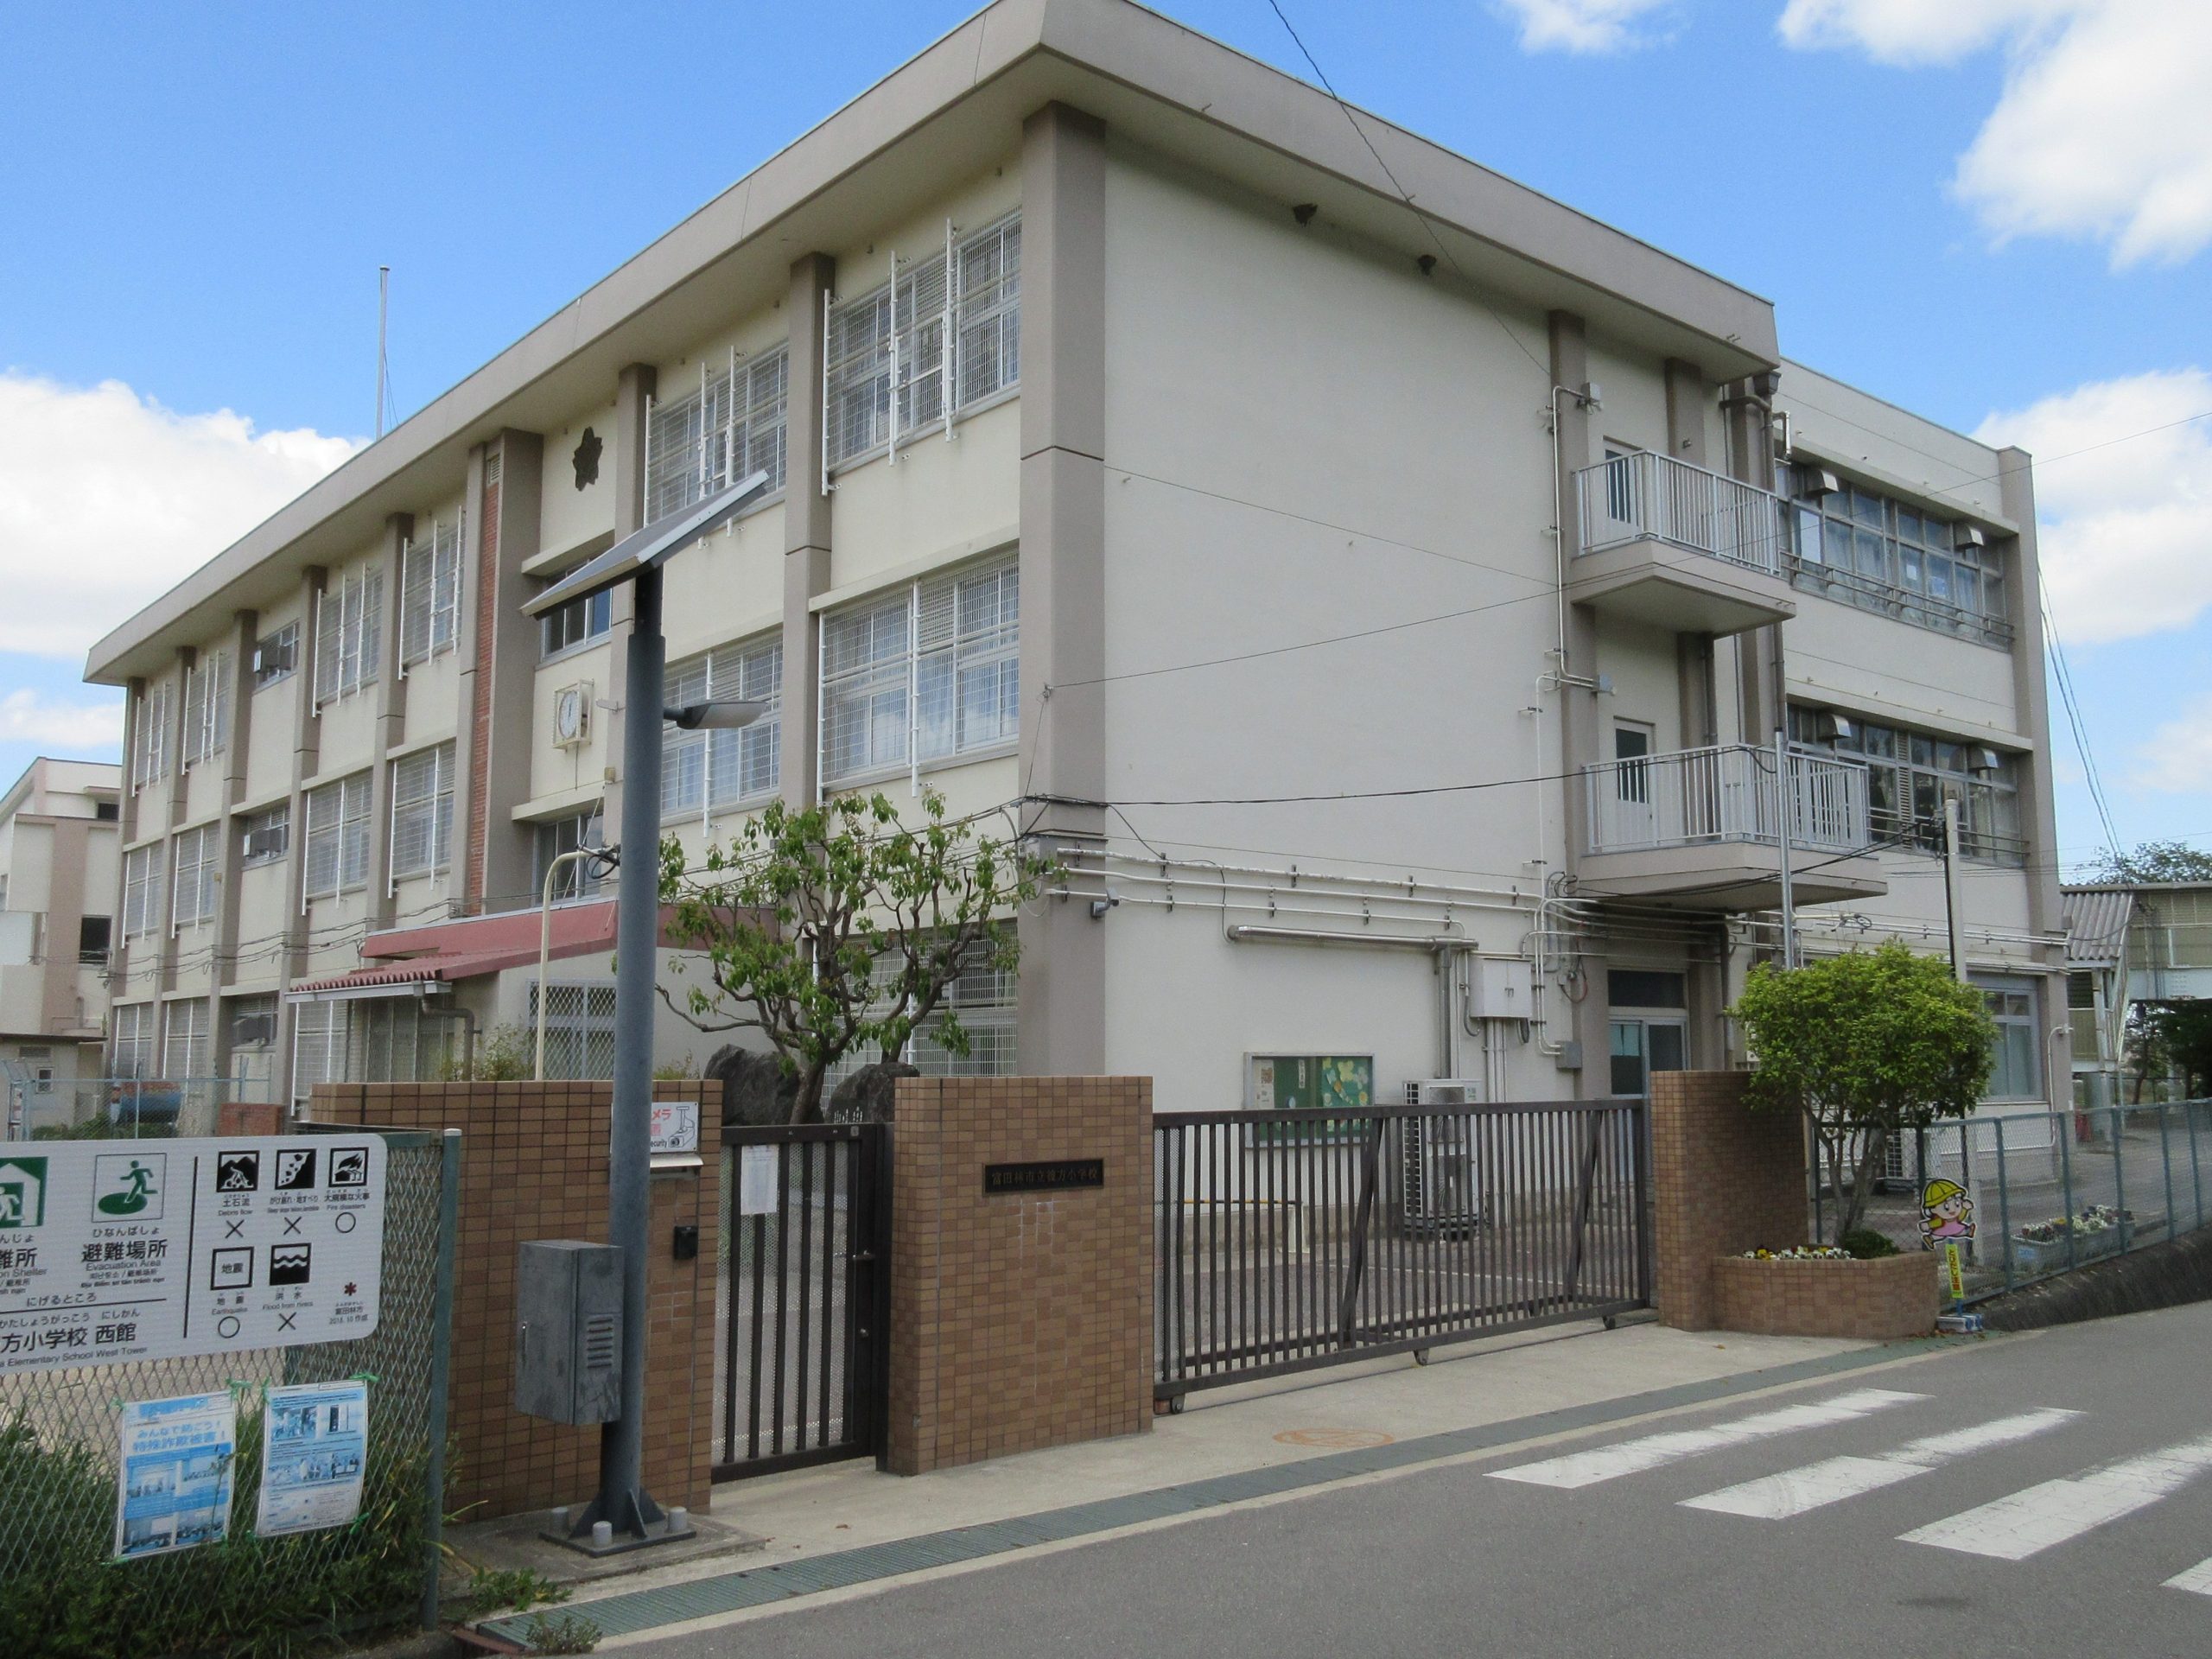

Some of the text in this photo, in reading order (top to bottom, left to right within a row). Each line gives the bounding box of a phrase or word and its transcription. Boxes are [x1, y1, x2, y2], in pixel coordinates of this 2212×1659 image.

[650, 1139, 667, 1148] ecurity
[92, 1227, 160, 1238] ひなんばしょ
[80, 1239, 168, 1262] 避難場所
[86, 1259, 162, 1271] Evacuation Area
[221, 1262, 244, 1274] 地震
[27, 1293, 97, 1307] にげるところ
[0, 1323, 137, 1354] 方小学校 西館
[7, 1355, 60, 1368] Elementary
[63, 1351, 93, 1363] School
[97, 1349, 118, 1357] West
[121, 1345, 148, 1356] Tower
